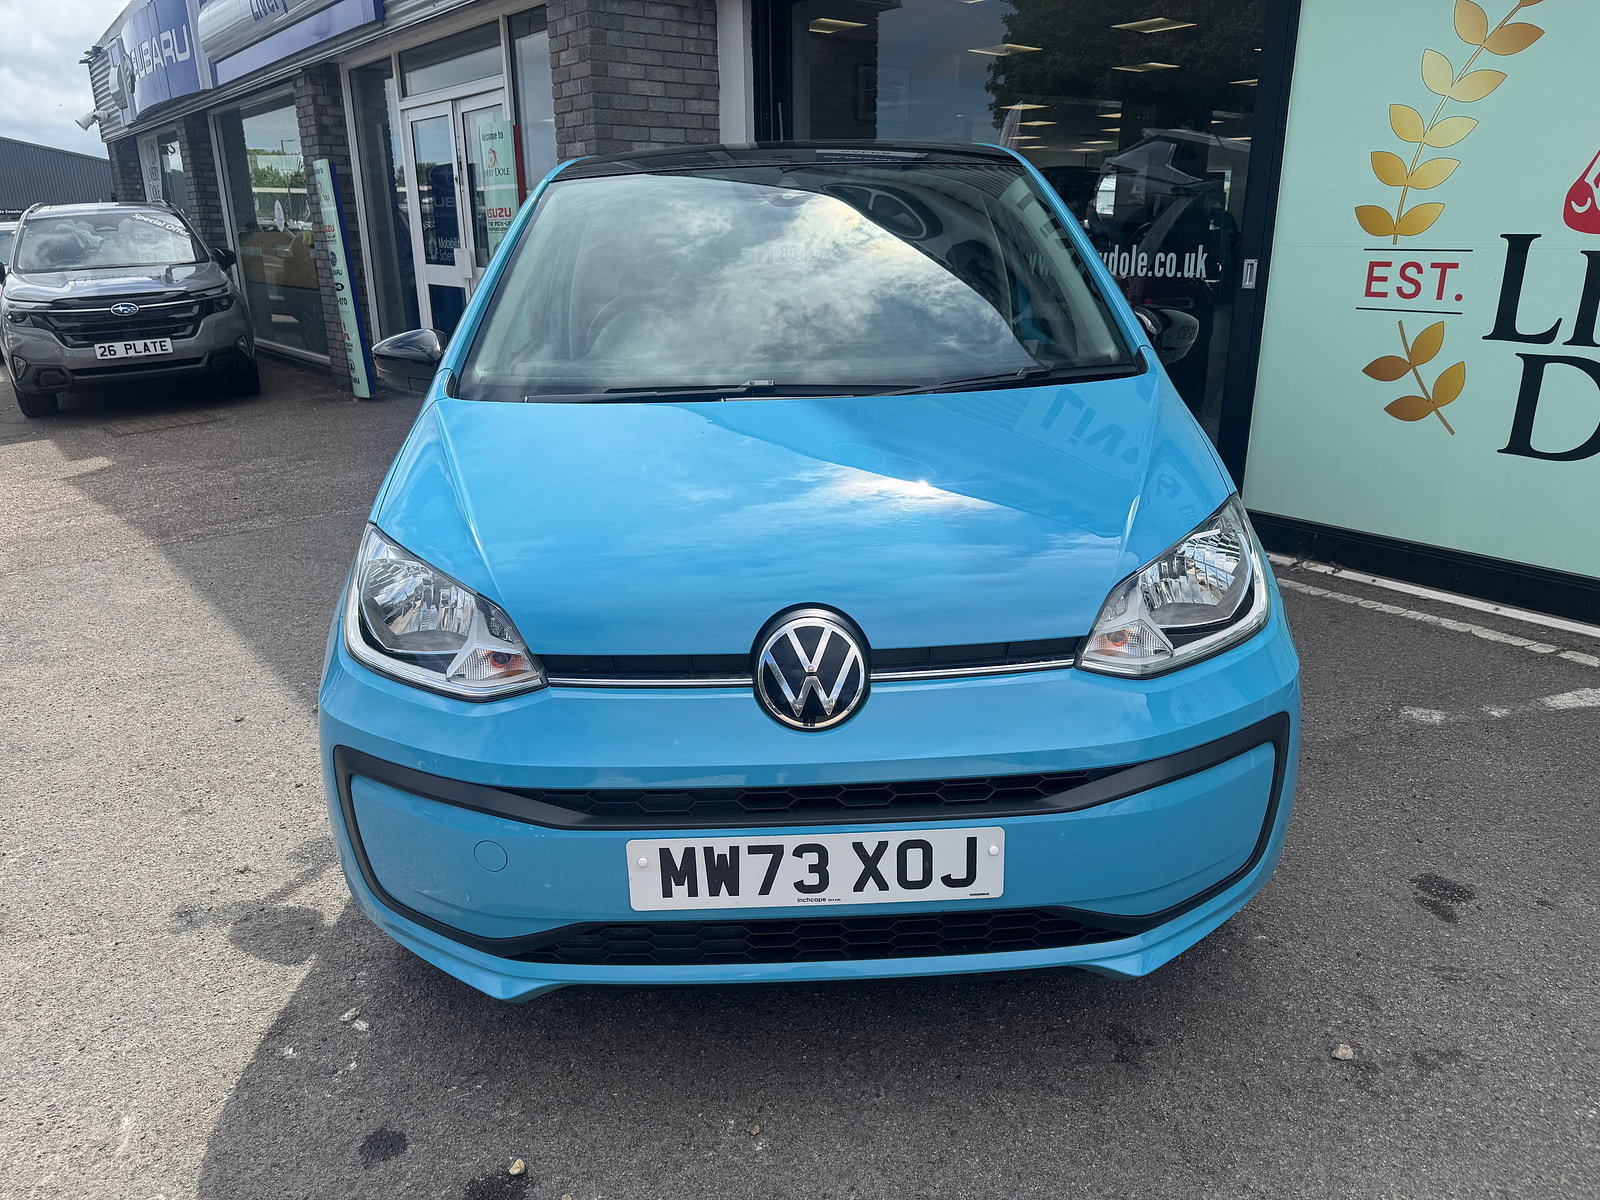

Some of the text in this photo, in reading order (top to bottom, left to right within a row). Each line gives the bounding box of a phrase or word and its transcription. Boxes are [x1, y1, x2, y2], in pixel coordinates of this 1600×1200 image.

[130, 24, 190, 79] SUBARU
[495, 167, 511, 177] DOLE
[487, 207, 512, 218] ISUZU
[132, 213, 165, 227] Special
[165, 224, 191, 236] Offer
[1364, 260, 1463, 302] EST.
[98, 340, 169, 358] 26 PLATE
[657, 836, 978, 899] MW73 XOJ
